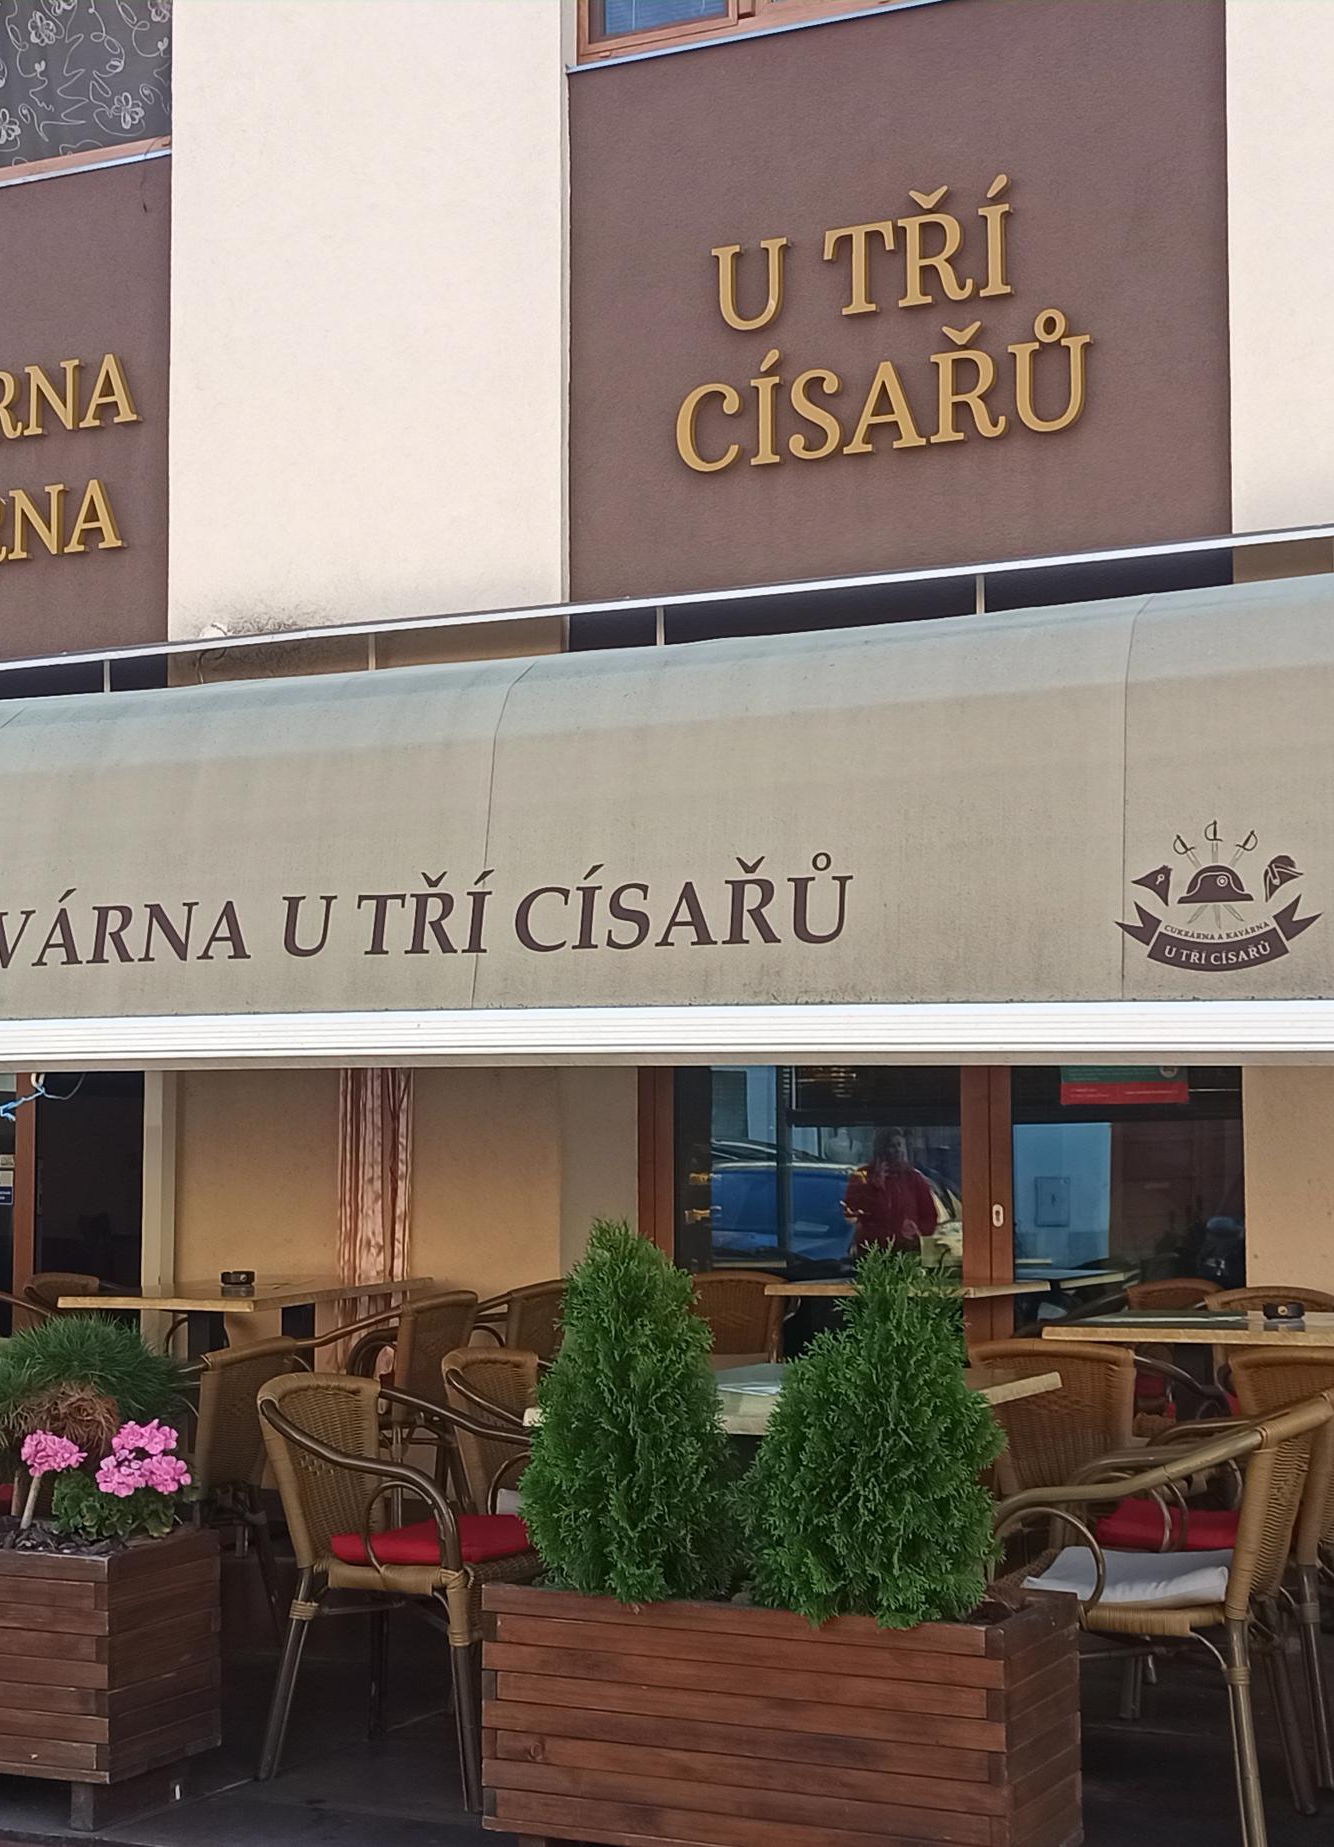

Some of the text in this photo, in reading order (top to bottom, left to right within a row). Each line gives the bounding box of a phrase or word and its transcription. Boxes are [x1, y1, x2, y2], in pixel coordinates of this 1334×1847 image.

[711, 173, 1015, 331] U TŘÍ
[675, 307, 1094, 474] CÍSAŘŮ
[281, 895, 339, 958] U
[356, 868, 496, 957] TŘÍ
[513, 850, 854, 953] CÍSAŘŮ
[1164, 946, 1178, 958] U
[1210, 941, 1272, 965] CÍSAŘŮ
